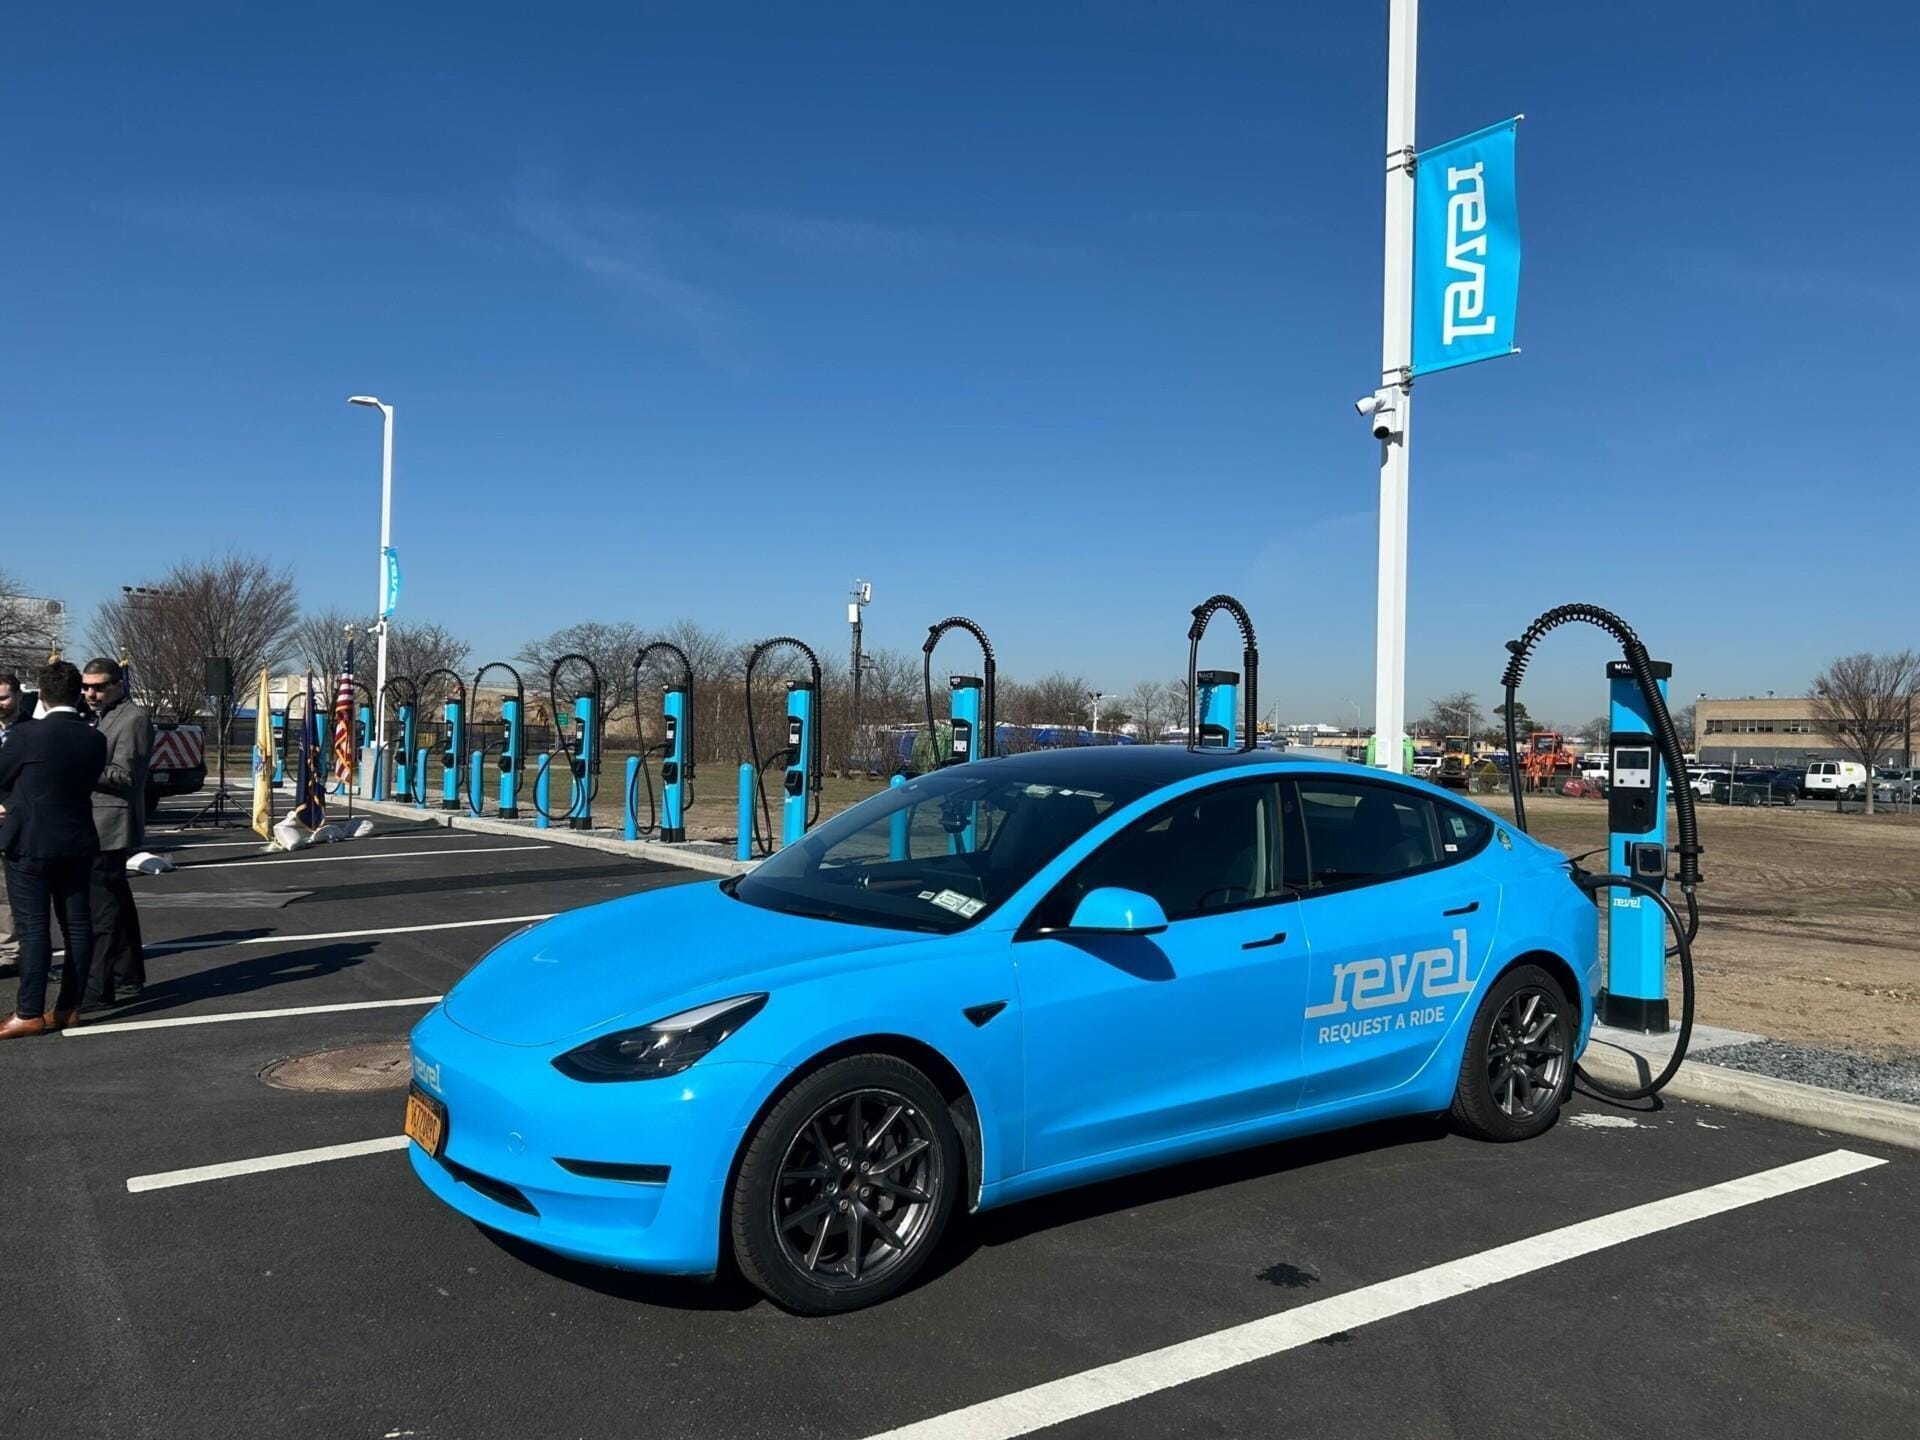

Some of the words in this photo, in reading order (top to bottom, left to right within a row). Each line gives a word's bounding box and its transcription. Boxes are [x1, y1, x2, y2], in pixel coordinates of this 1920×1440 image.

[1443, 161, 1496, 345] revel
[1613, 897, 1641, 908] revel
[1304, 928, 1476, 1019] revel
[1318, 1015, 1392, 1044] REQUEST
[1395, 1014, 1406, 1029] A
[1410, 1006, 1445, 1027] RIDE
[414, 1055, 442, 1093] revel
